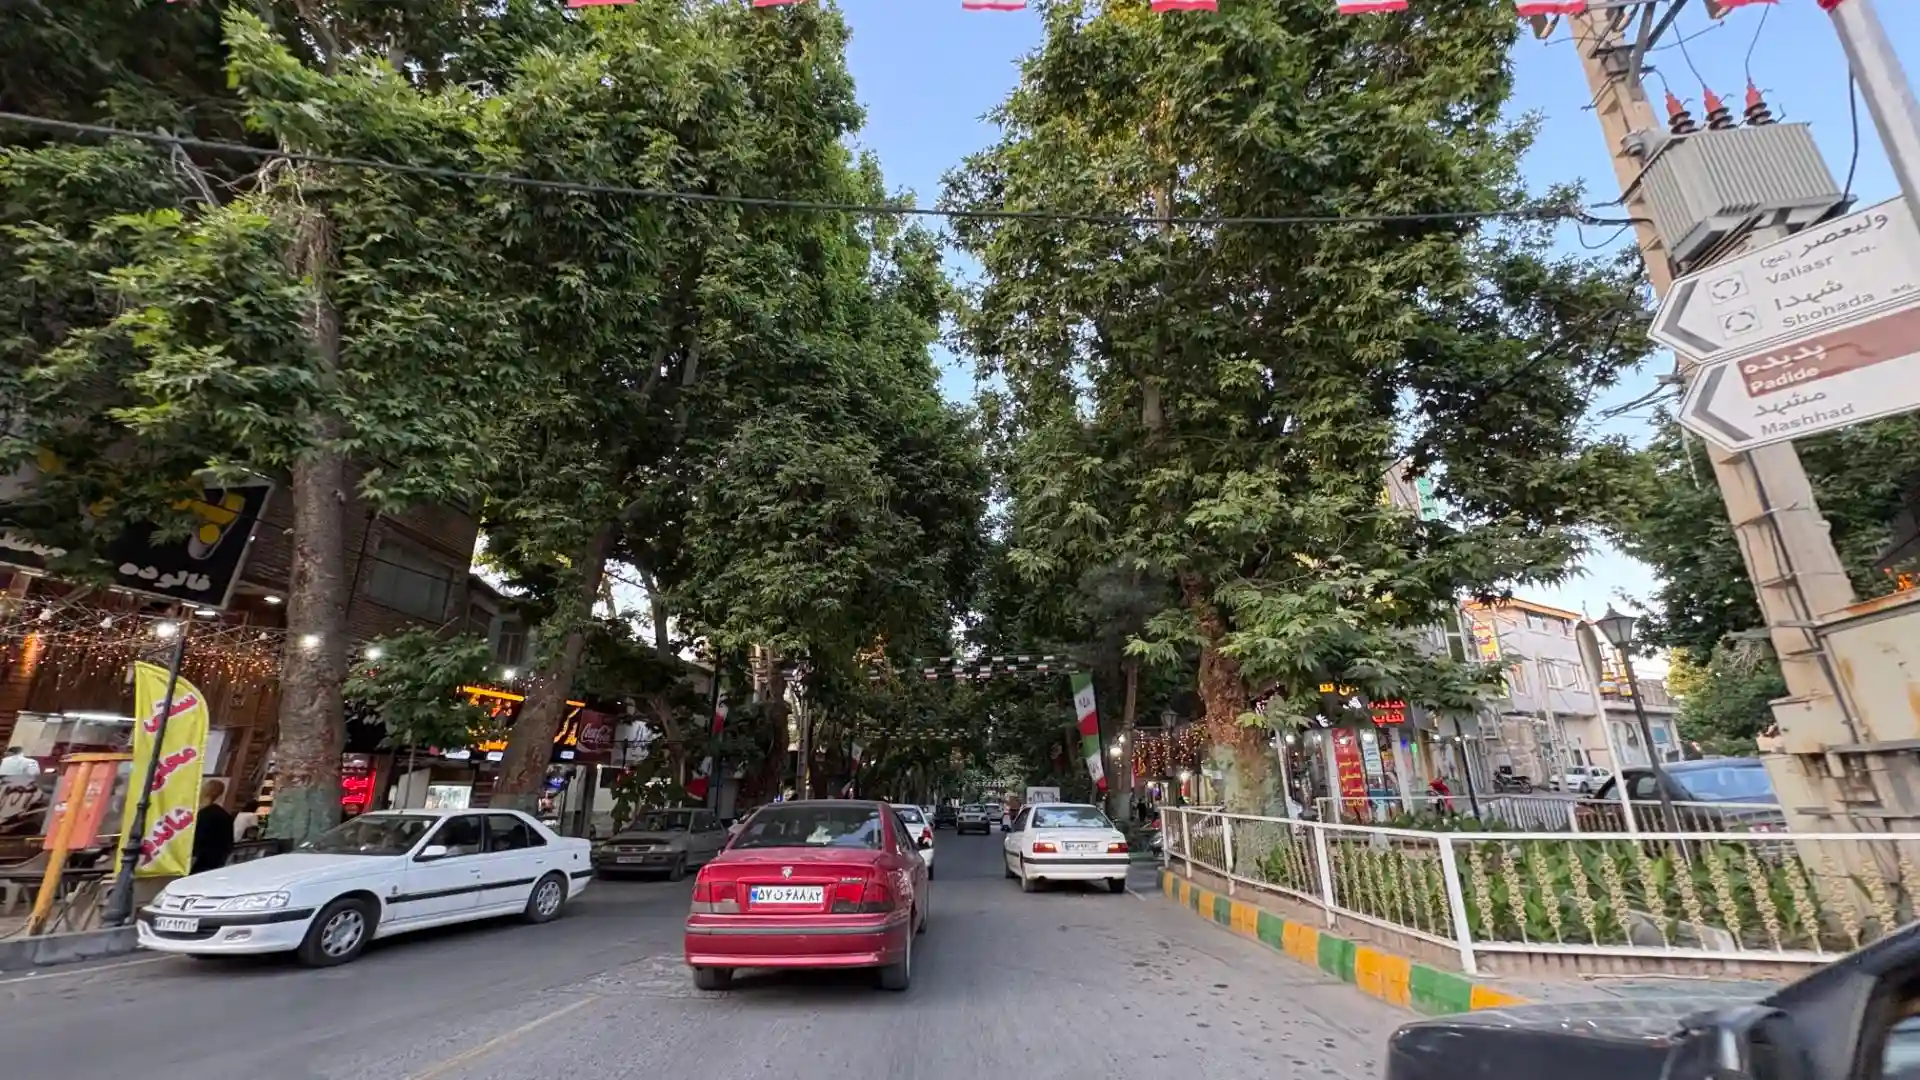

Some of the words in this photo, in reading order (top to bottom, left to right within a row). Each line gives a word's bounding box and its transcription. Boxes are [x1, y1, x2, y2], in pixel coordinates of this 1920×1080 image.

[1800, 213, 1888, 259] ولیعصر
[1765, 255, 1834, 285] Valiasr
[1774, 279, 1844, 311] شهدا
[1782, 293, 1876, 328] Shohada
[1743, 344, 1828, 375] پدیده
[1750, 367, 1820, 393] Padide
[1753, 391, 1827, 418] مشهد
[1760, 403, 1855, 436] Mashhad
[118, 562, 211, 591] فالوده
